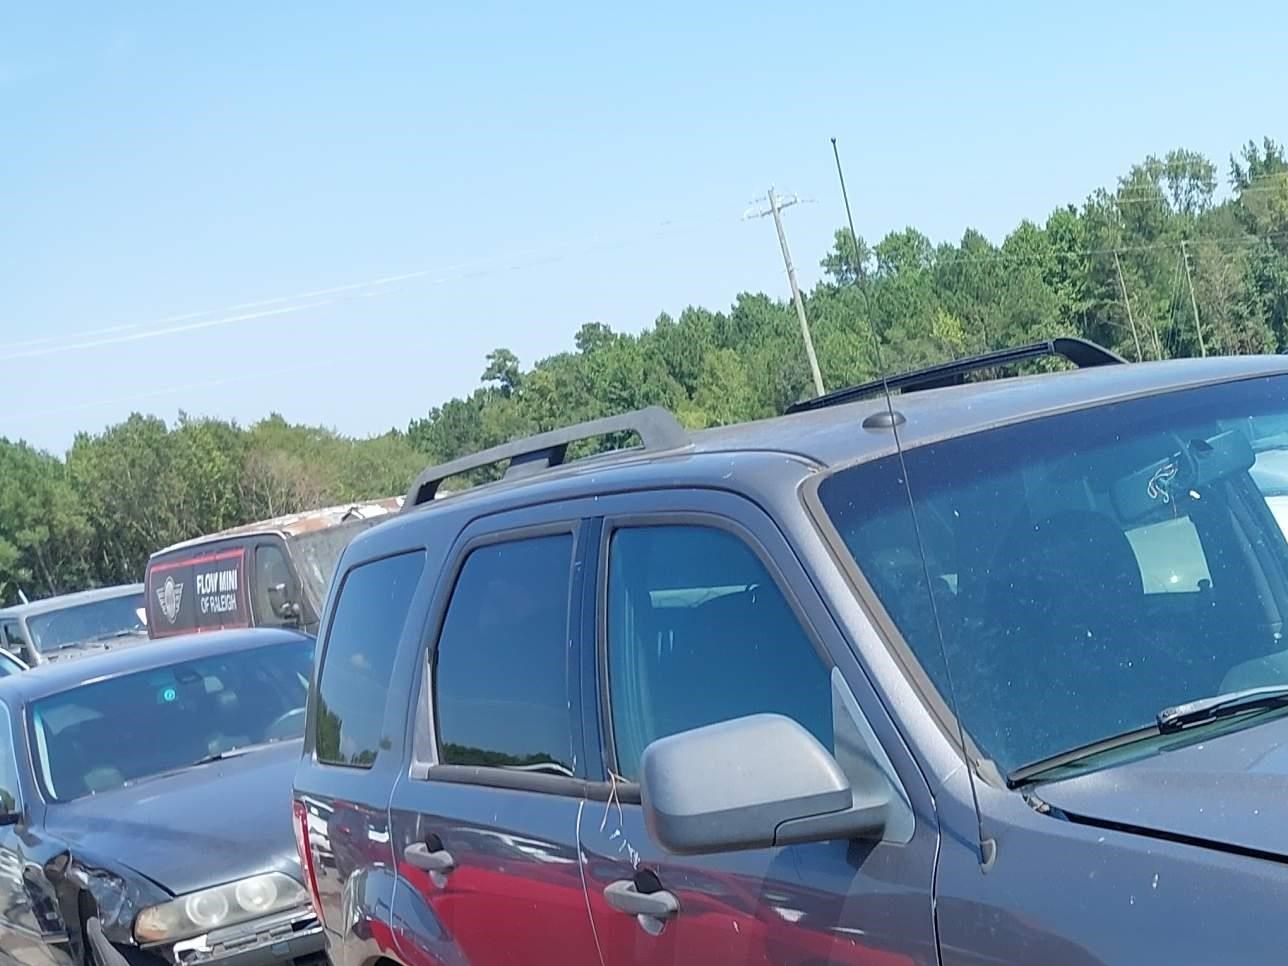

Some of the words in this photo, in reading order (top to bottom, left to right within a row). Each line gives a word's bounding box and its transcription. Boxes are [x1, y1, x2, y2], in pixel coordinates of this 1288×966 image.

[196, 571, 218, 595] FLOW
[219, 569, 238, 592] MINI
[200, 596, 209, 614] OF
[210, 593, 238, 613] RALEIGH
